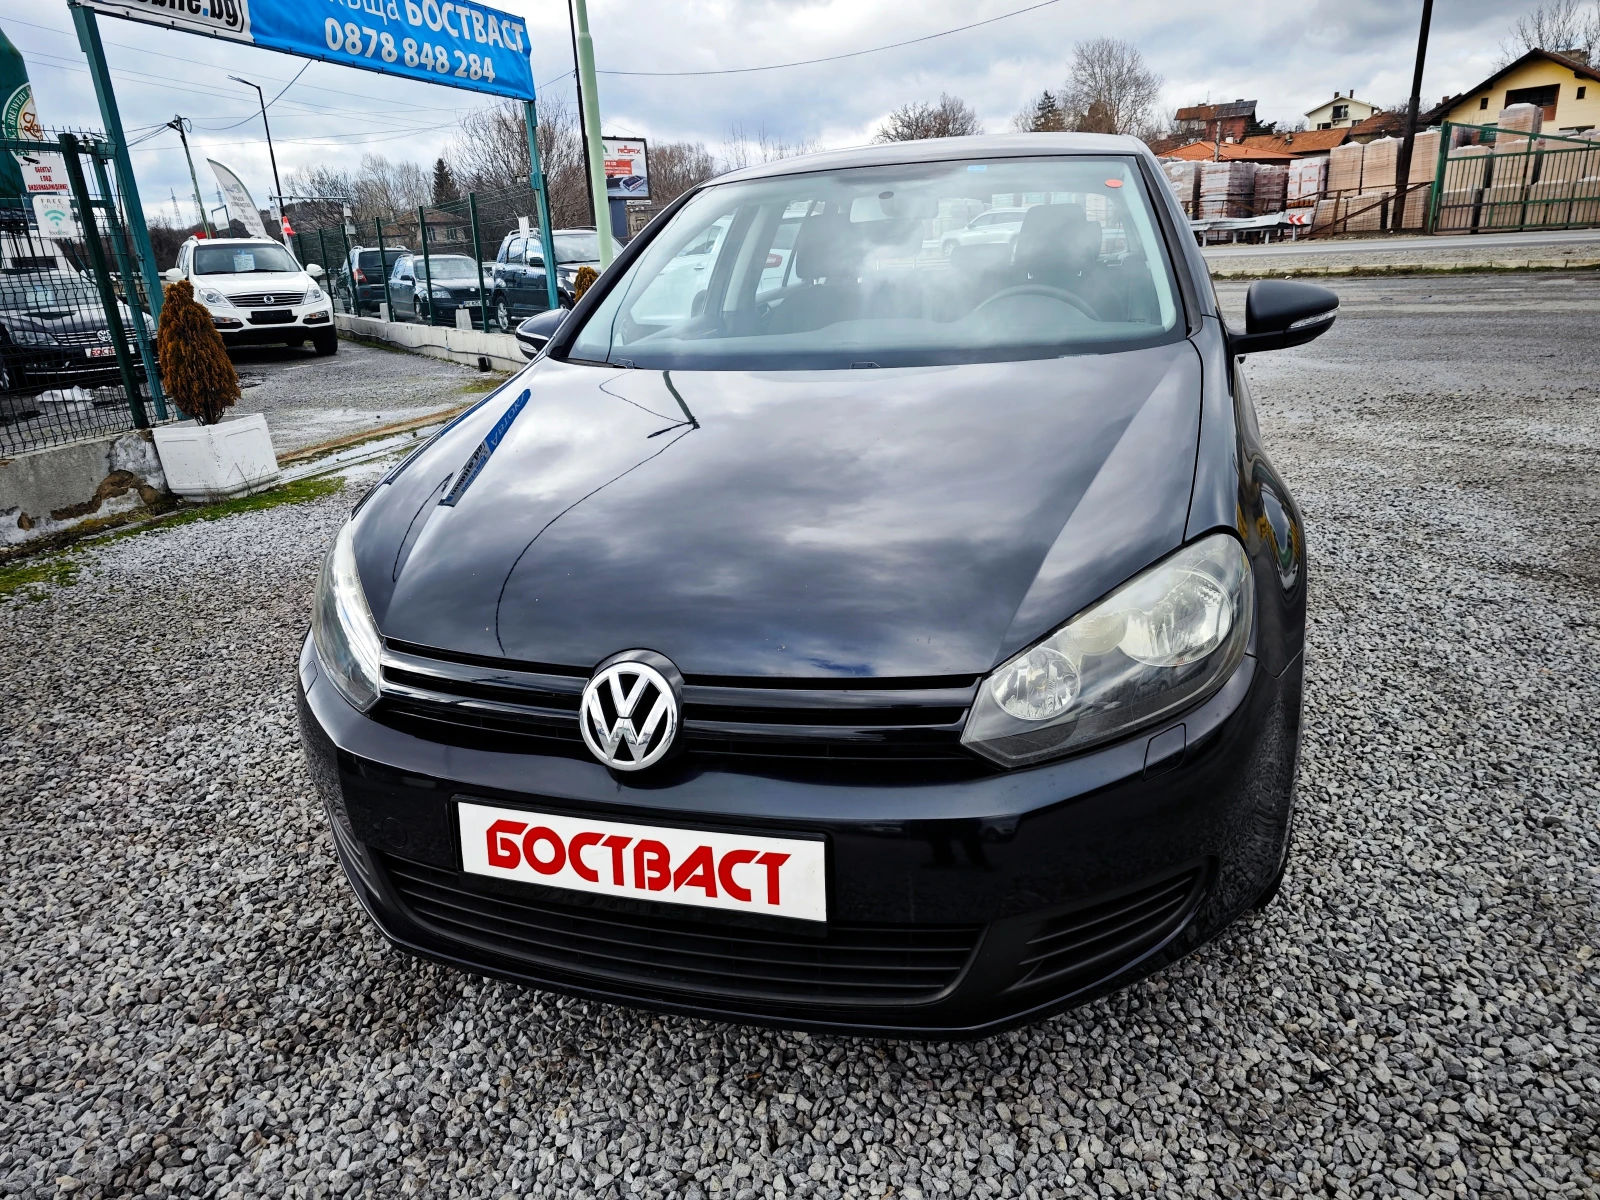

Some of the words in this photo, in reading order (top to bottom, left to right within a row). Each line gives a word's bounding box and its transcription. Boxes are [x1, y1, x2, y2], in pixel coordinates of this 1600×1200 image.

[324, 17, 398, 63] 0878
[402, 37, 451, 74] 848
[454, 50, 496, 83] 284
[404, 0, 524, 54] БОСТВАСТ
[486, 818, 792, 906] БОСТВАСТ
